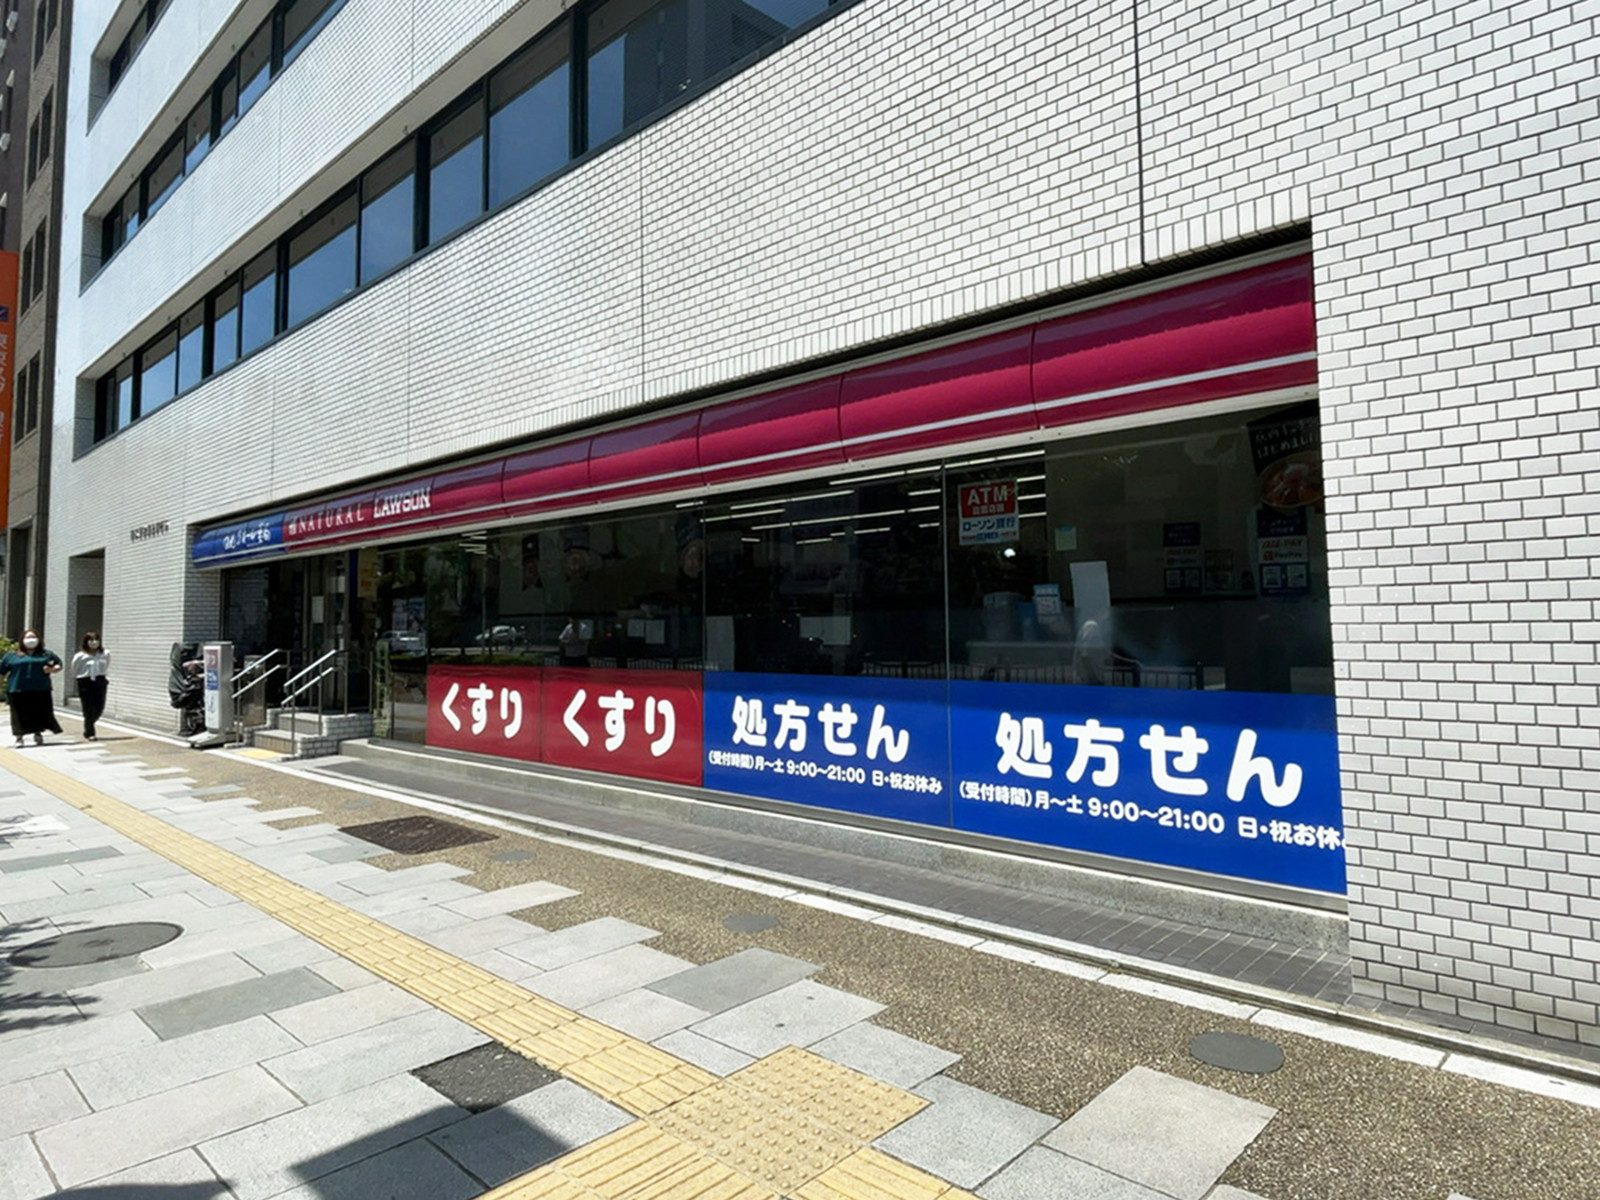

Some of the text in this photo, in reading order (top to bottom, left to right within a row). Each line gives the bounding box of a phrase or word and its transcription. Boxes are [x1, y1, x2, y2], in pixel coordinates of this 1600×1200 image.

[299, 486, 432, 534] NATURAL LAWSON
[967, 485, 1008, 506] ATM
[441, 682, 522, 739] くすり
[563, 689, 676, 757] くすり
[731, 695, 910, 763] 処方せん
[995, 712, 1303, 808] 処方せん
